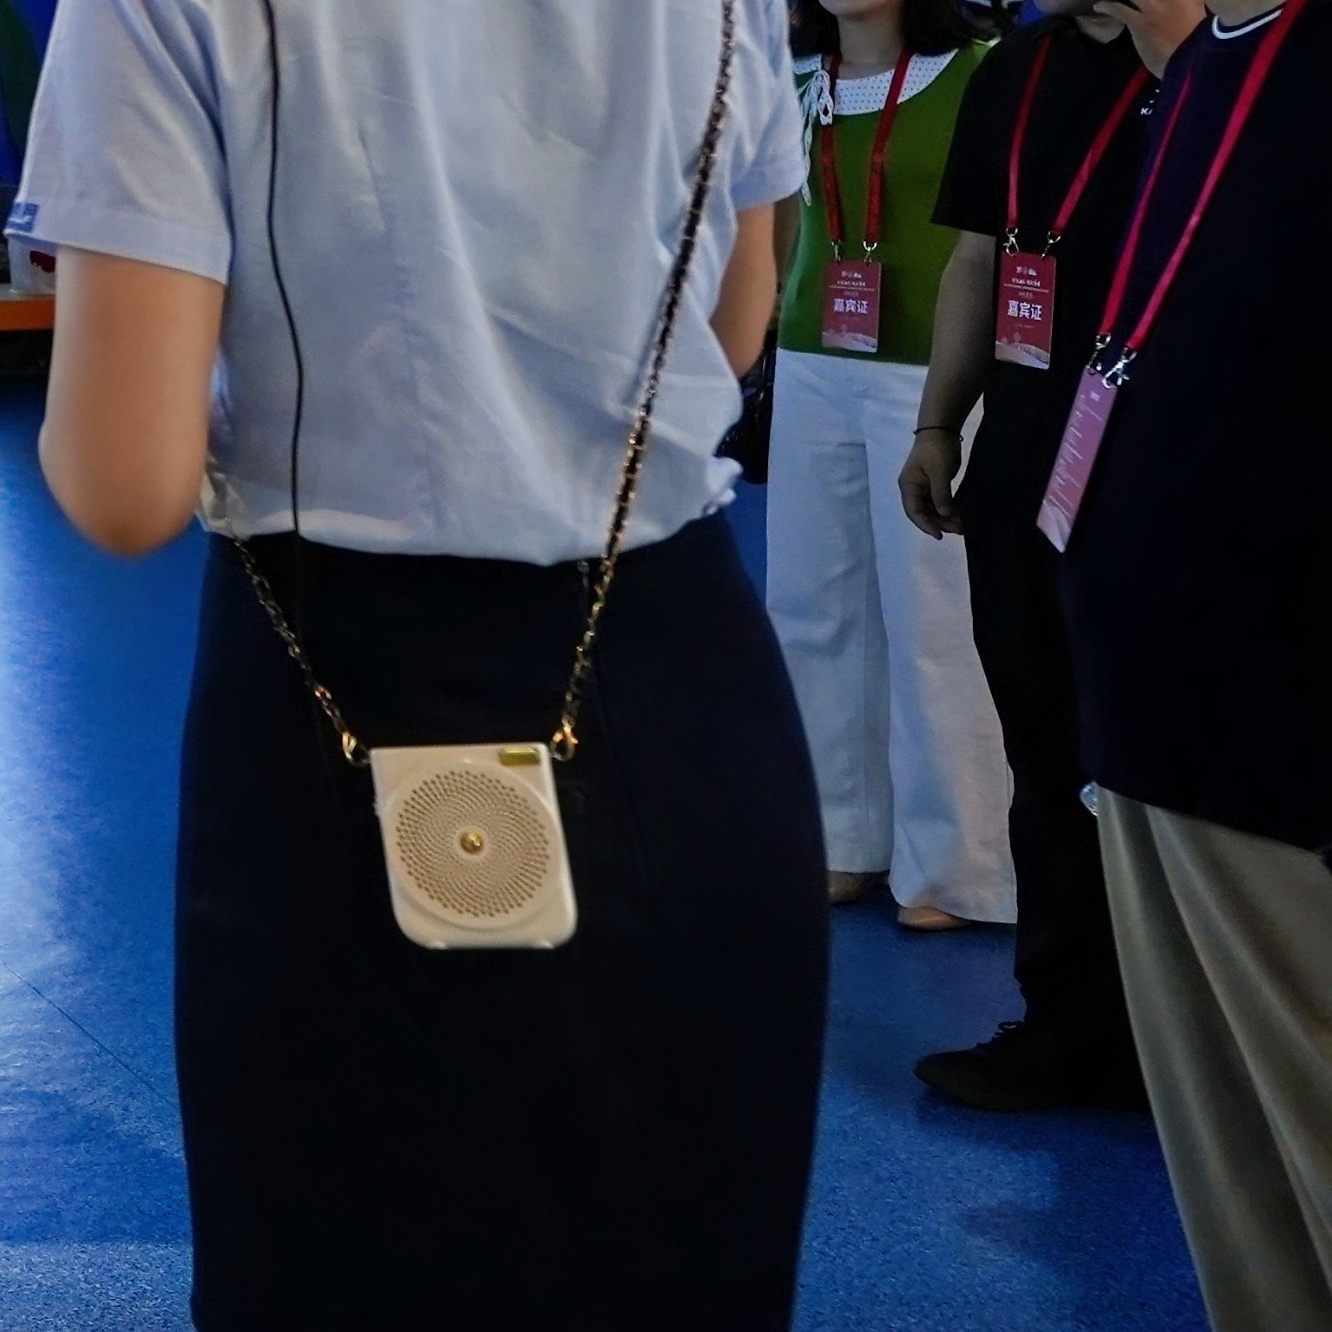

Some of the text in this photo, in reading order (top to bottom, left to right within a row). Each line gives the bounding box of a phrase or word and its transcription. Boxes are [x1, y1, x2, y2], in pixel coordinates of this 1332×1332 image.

[833, 298, 869, 315] 嘉宾证
[1007, 299, 1043, 321] 嘉宾证
